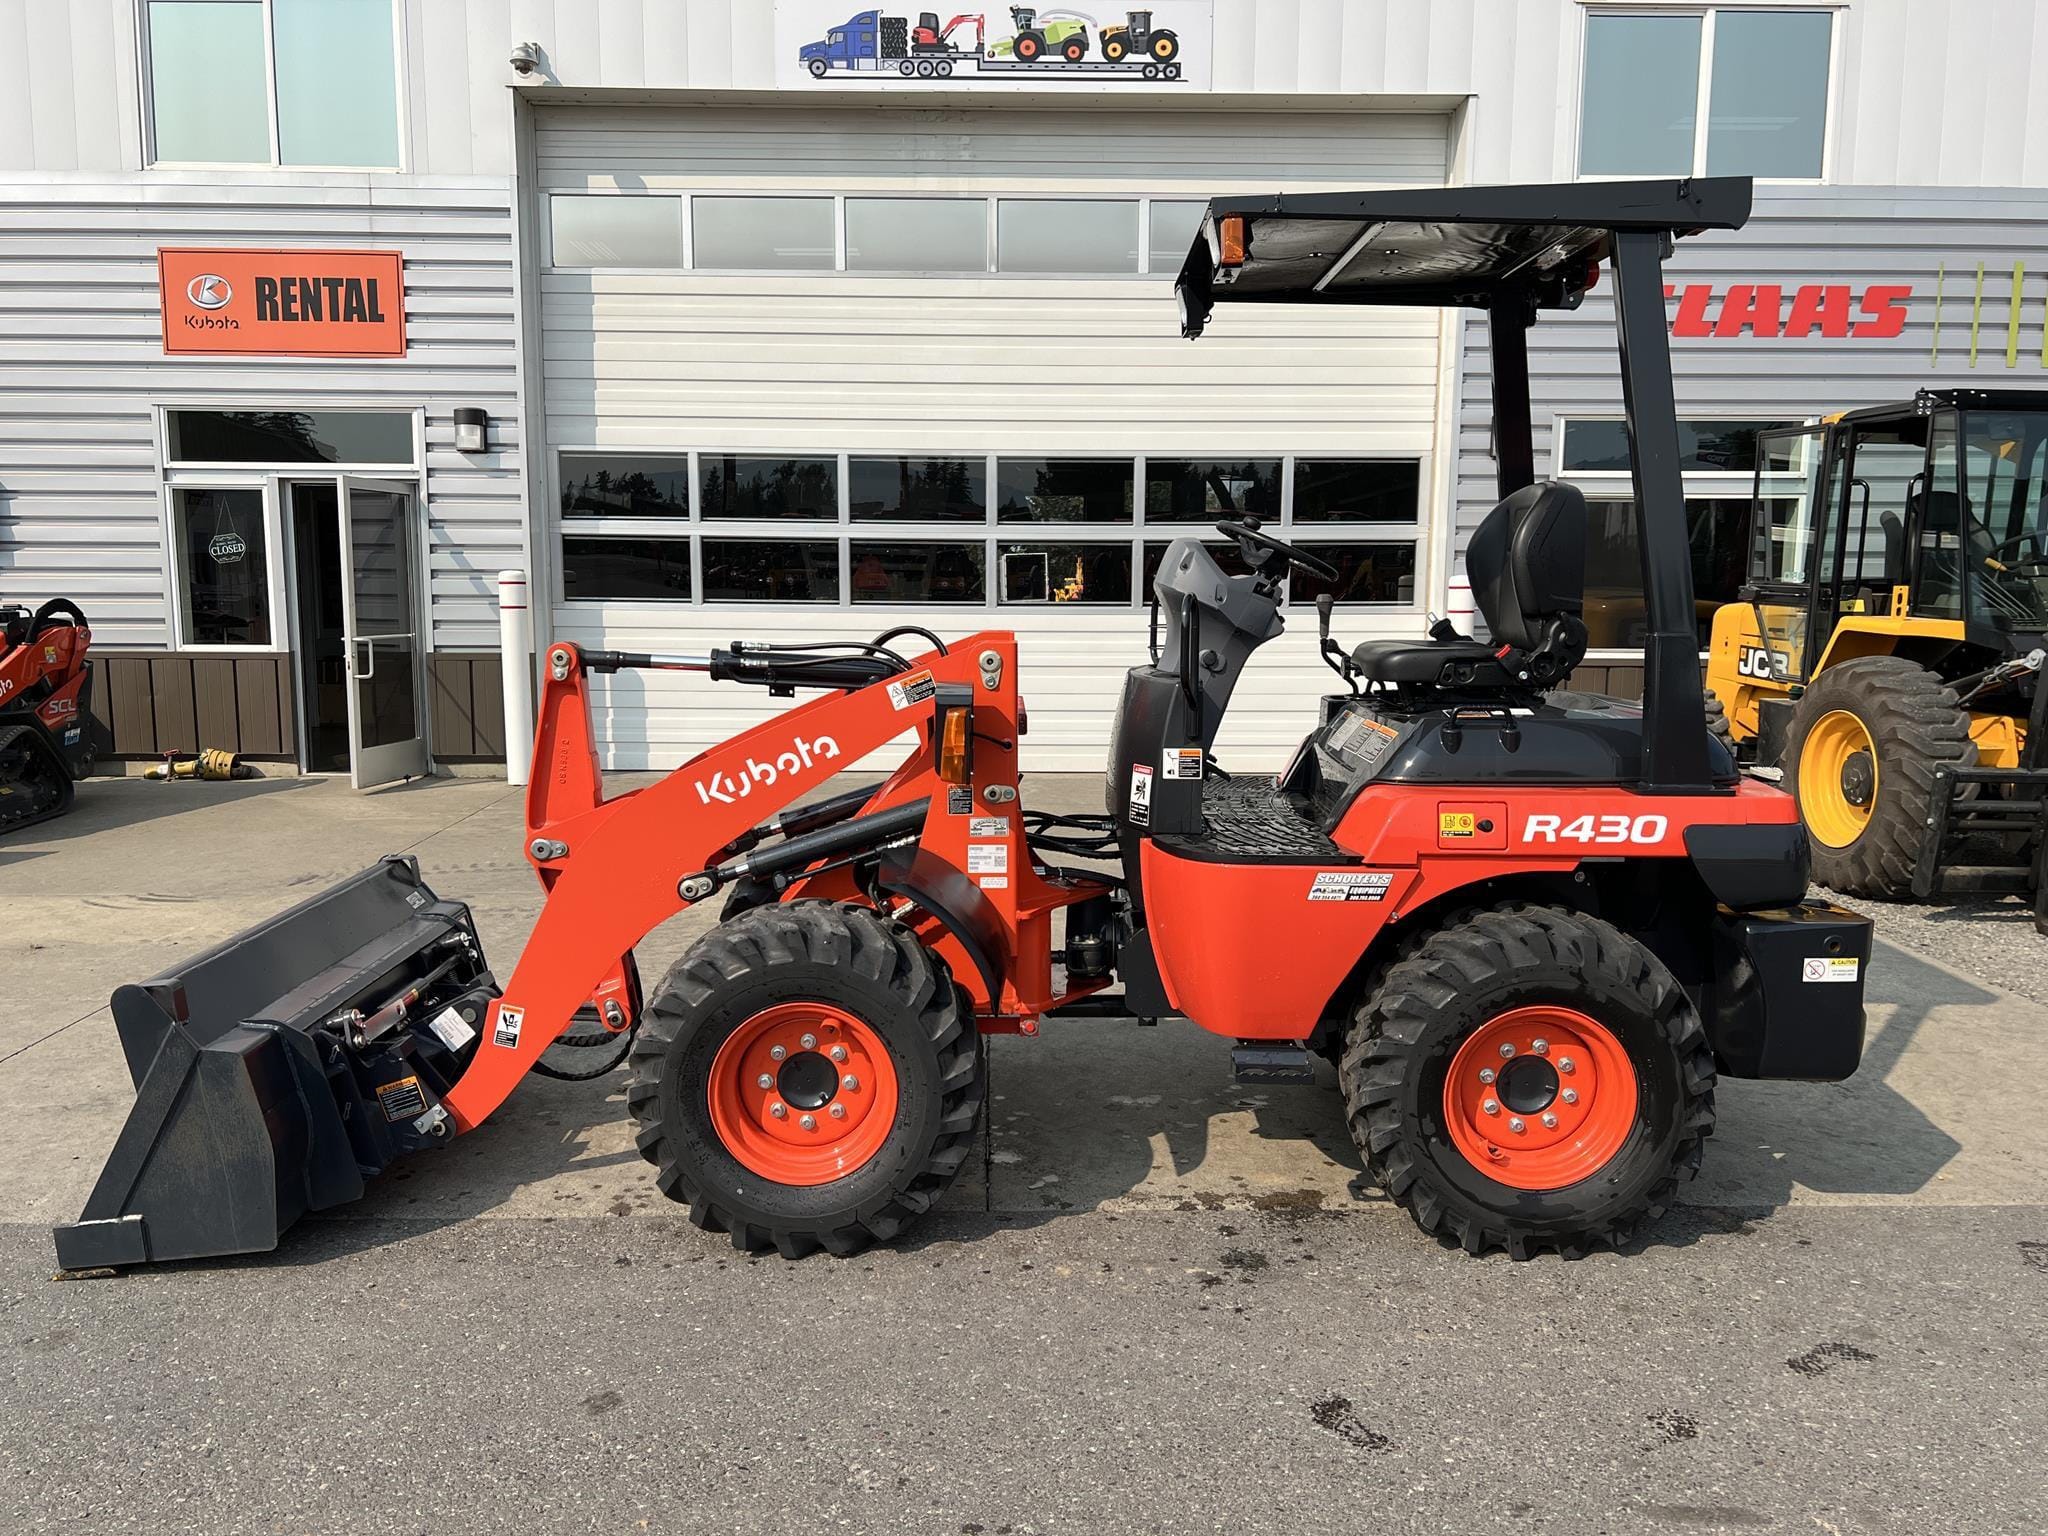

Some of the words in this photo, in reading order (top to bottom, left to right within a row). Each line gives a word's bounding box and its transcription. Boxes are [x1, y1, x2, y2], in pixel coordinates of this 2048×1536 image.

[255, 276, 385, 323] RENTAL
[1664, 285, 1912, 338] LAAS
[184, 314, 240, 330] Kubota
[211, 543, 245, 556] CLOSED
[1739, 648, 1789, 679] JCB
[48, 698, 77, 714] SCL
[694, 735, 841, 805] Kubota
[1521, 814, 1668, 844] R430
[1316, 873, 1392, 885] SCHOLTEN'S
